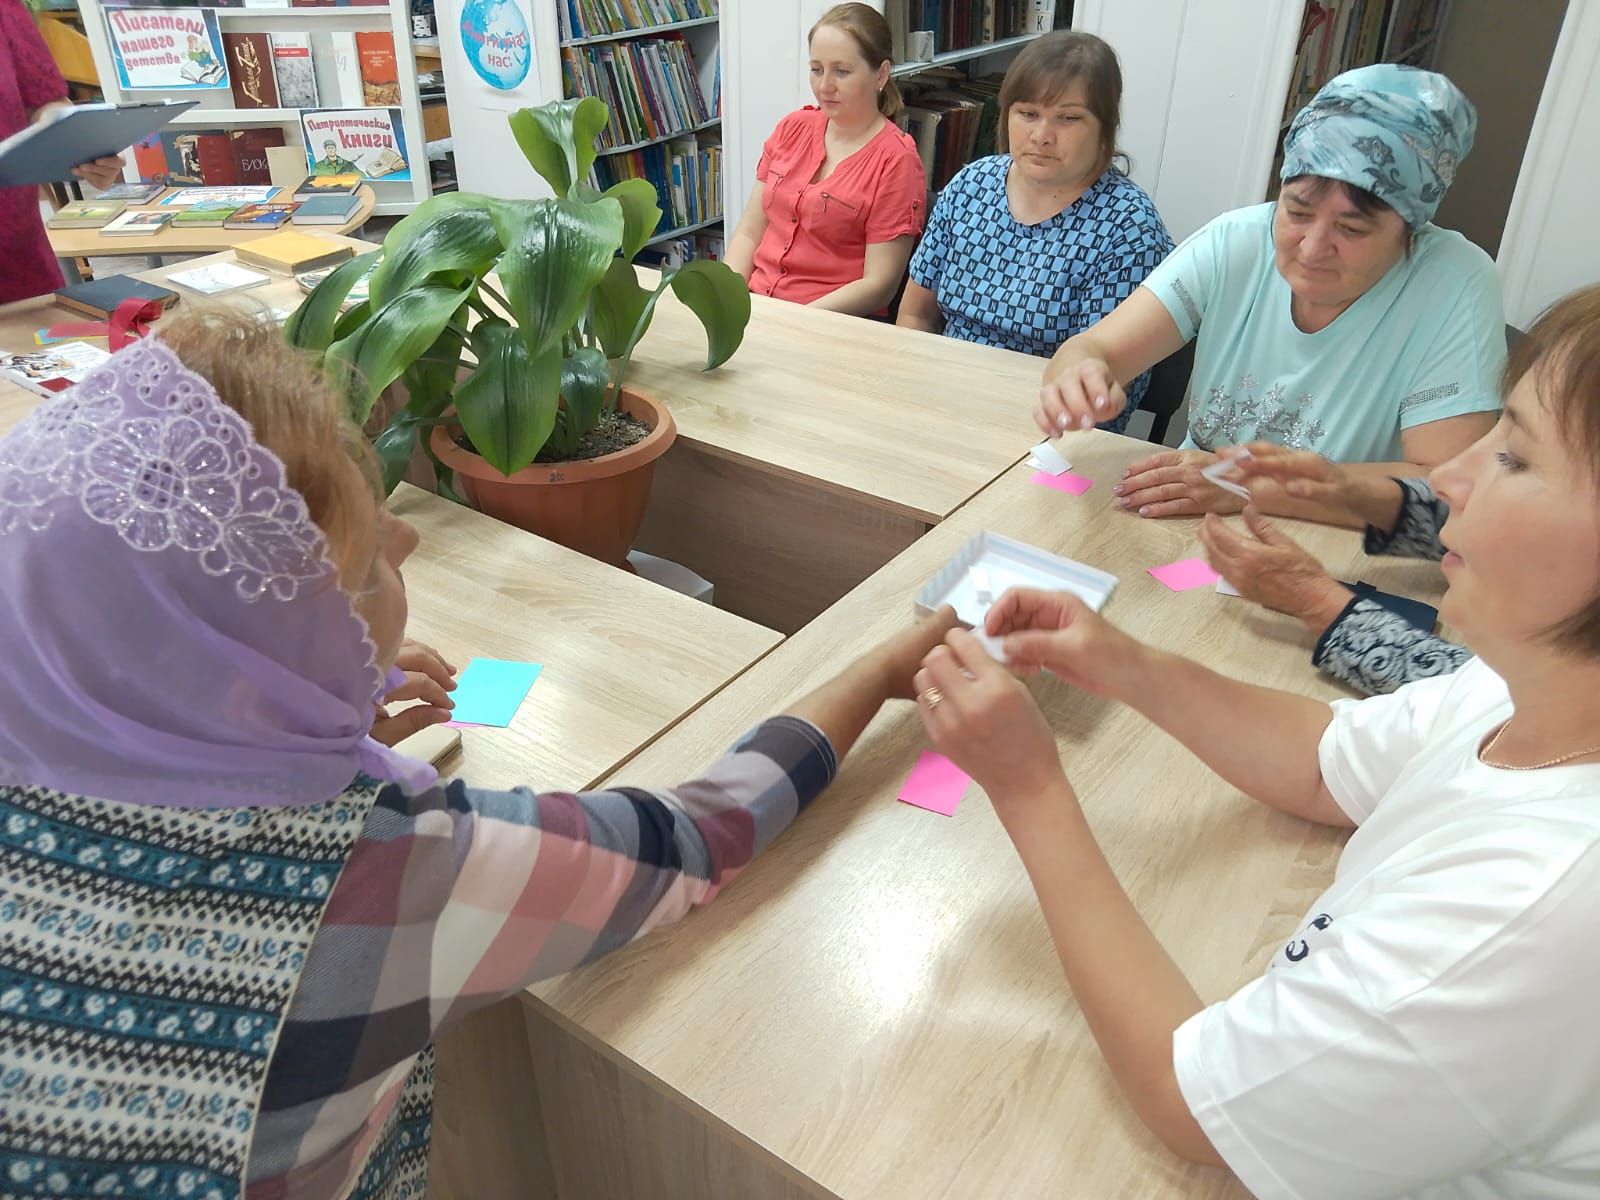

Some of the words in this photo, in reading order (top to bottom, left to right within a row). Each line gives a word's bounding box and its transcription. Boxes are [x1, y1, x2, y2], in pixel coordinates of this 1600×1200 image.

[111, 10, 205, 36] Писатели
[120, 35, 175, 53] нашего
[125, 52, 181, 70] детства
[306, 117, 391, 132] Патриотические
